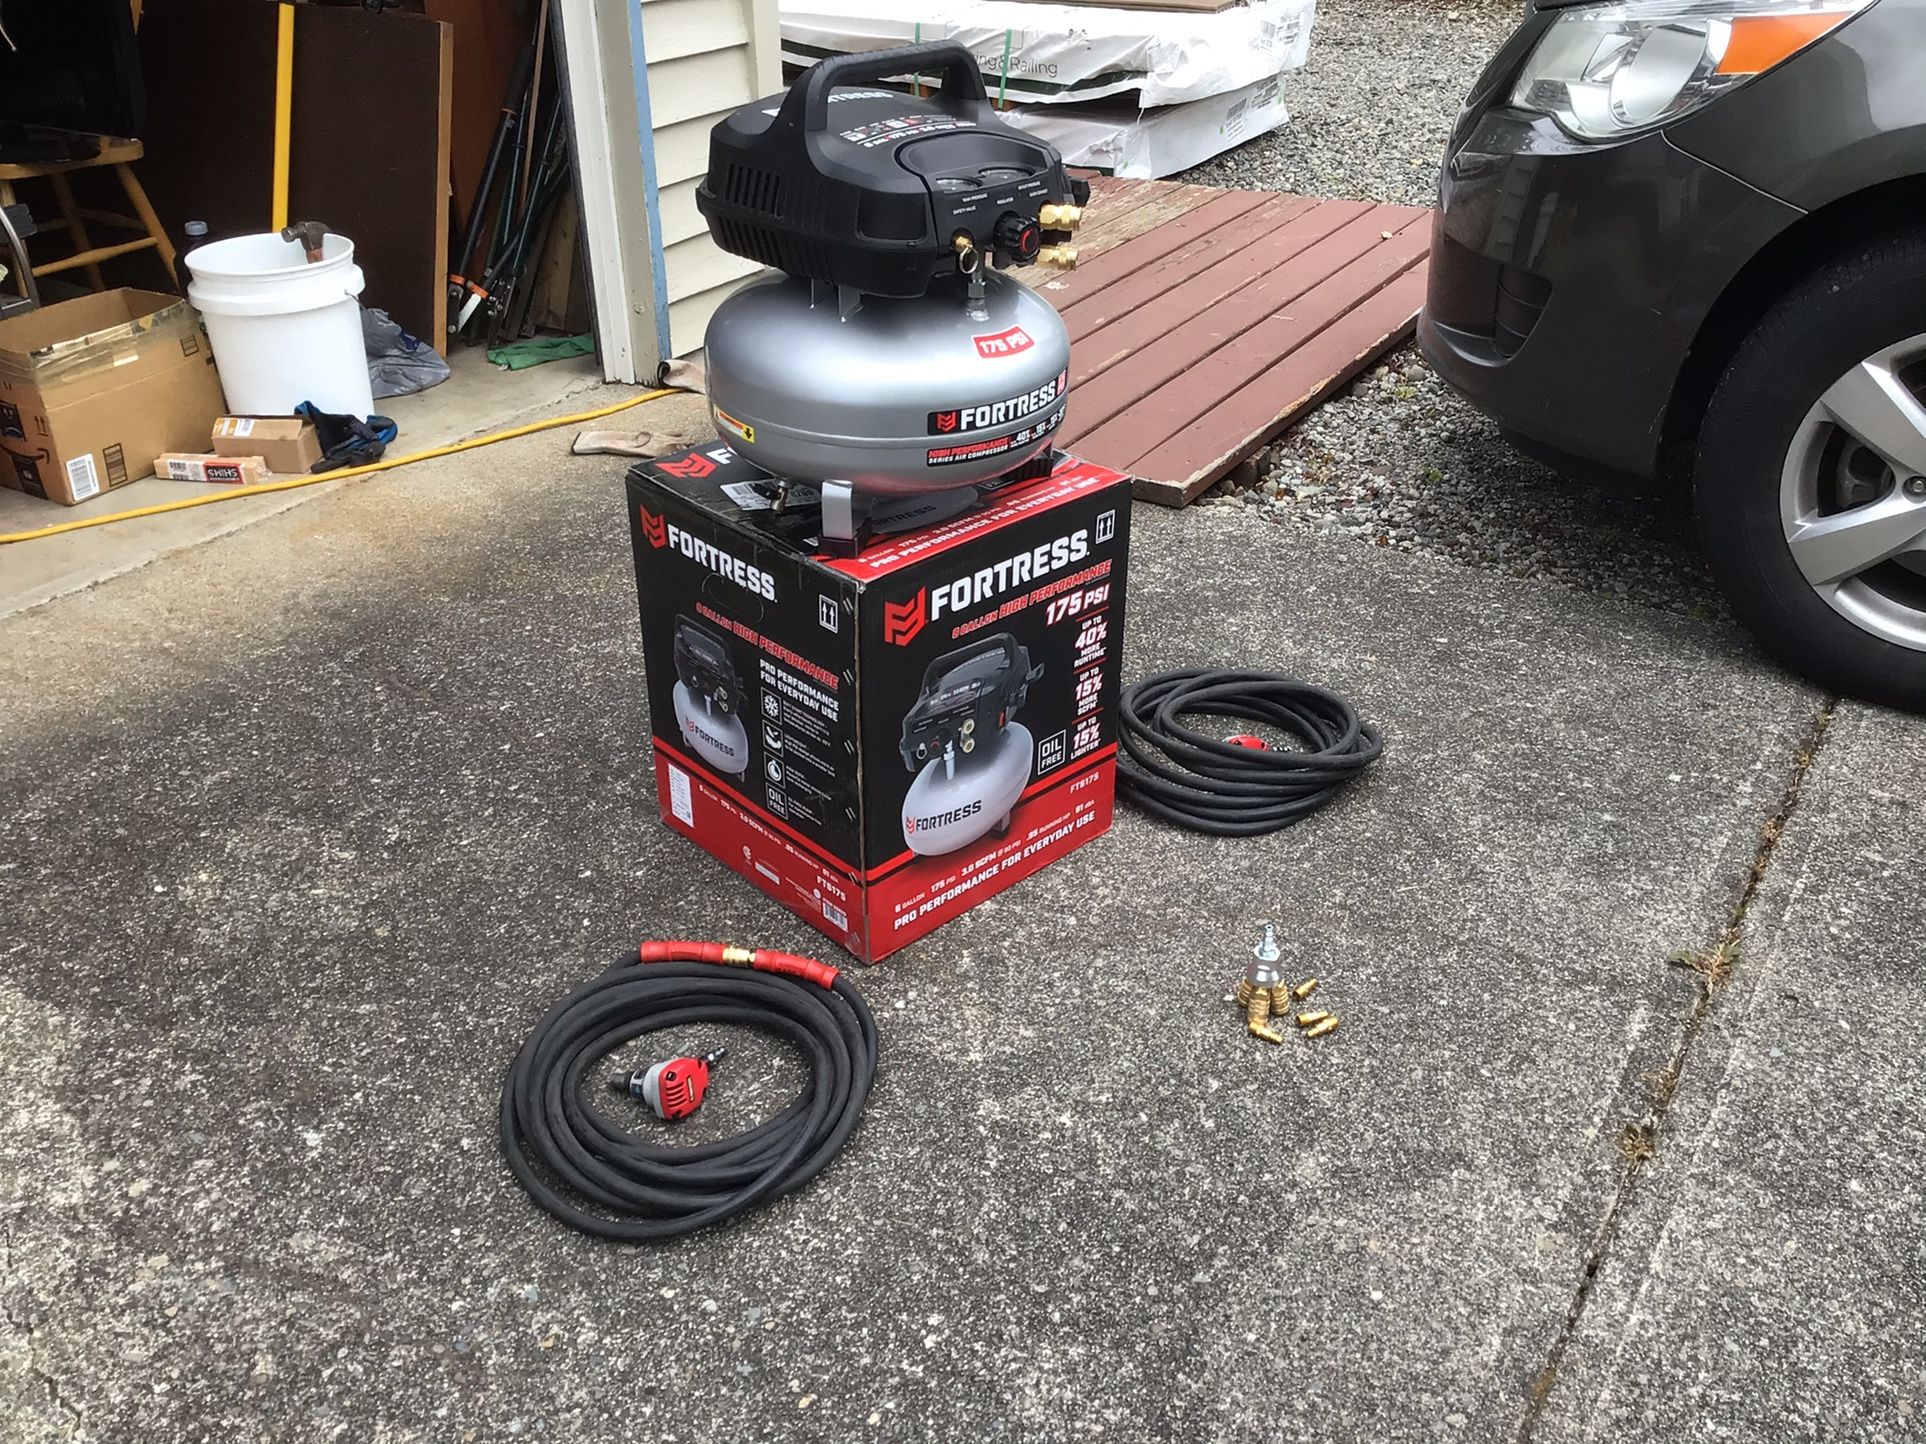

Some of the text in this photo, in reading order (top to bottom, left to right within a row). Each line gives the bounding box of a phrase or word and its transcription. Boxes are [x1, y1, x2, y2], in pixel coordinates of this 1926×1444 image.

[973, 51, 997, 70] ing
[1010, 56, 1057, 78] Railing
[979, 331, 1030, 354] 175 PSI
[960, 380, 1056, 430] FORTRESS
[928, 445, 1008, 464] SERIES AIR COMPRESSOR
[951, 436, 1010, 455] PERFORMANCE
[869, 476, 1100, 568] PRO PERFORMANCE FOR EVERYDAY USE
[667, 523, 776, 603] FORTRESS
[931, 528, 1089, 622] FORTRESS
[952, 559, 1113, 639] 6 GALLON HIGH PERFORMANCE
[1045, 583, 1111, 627] 175 PSI
[1075, 621, 1108, 649] 40%
[1082, 615, 1102, 630] UP TO
[702, 606, 732, 631] GALLON
[733, 620, 759, 645] HIGH
[759, 635, 840, 690] PERFORMANCE
[1081, 642, 1101, 657] MORE
[760, 658, 840, 711] PRO PERFORMANCE
[1075, 673, 1103, 700] 15%
[1080, 667, 1099, 682] UP TO
[760, 670, 776, 687] FOR
[777, 680, 820, 711] EVERYDAY
[821, 707, 838, 722] USE
[1078, 692, 1098, 708] MORE
[1073, 723, 1100, 750] 15%
[1077, 716, 1097, 732] UP TO
[695, 727, 735, 757] FORTRESS
[1042, 738, 1062, 757] OIL
[1041, 750, 1062, 769] FREE
[768, 787, 784, 806] OIL
[769, 799, 786, 815] FREE
[915, 800, 982, 832] FORTRESS
[894, 811, 1096, 930] PRO PERFORMANCE FOR EVERYDAY USE
[902, 891, 926, 909] GALLON
[930, 879, 946, 893] 175
[961, 864, 974, 877] 3.0
[974, 852, 997, 871] SCFM
[1039, 817, 1063, 834] RUNNING
